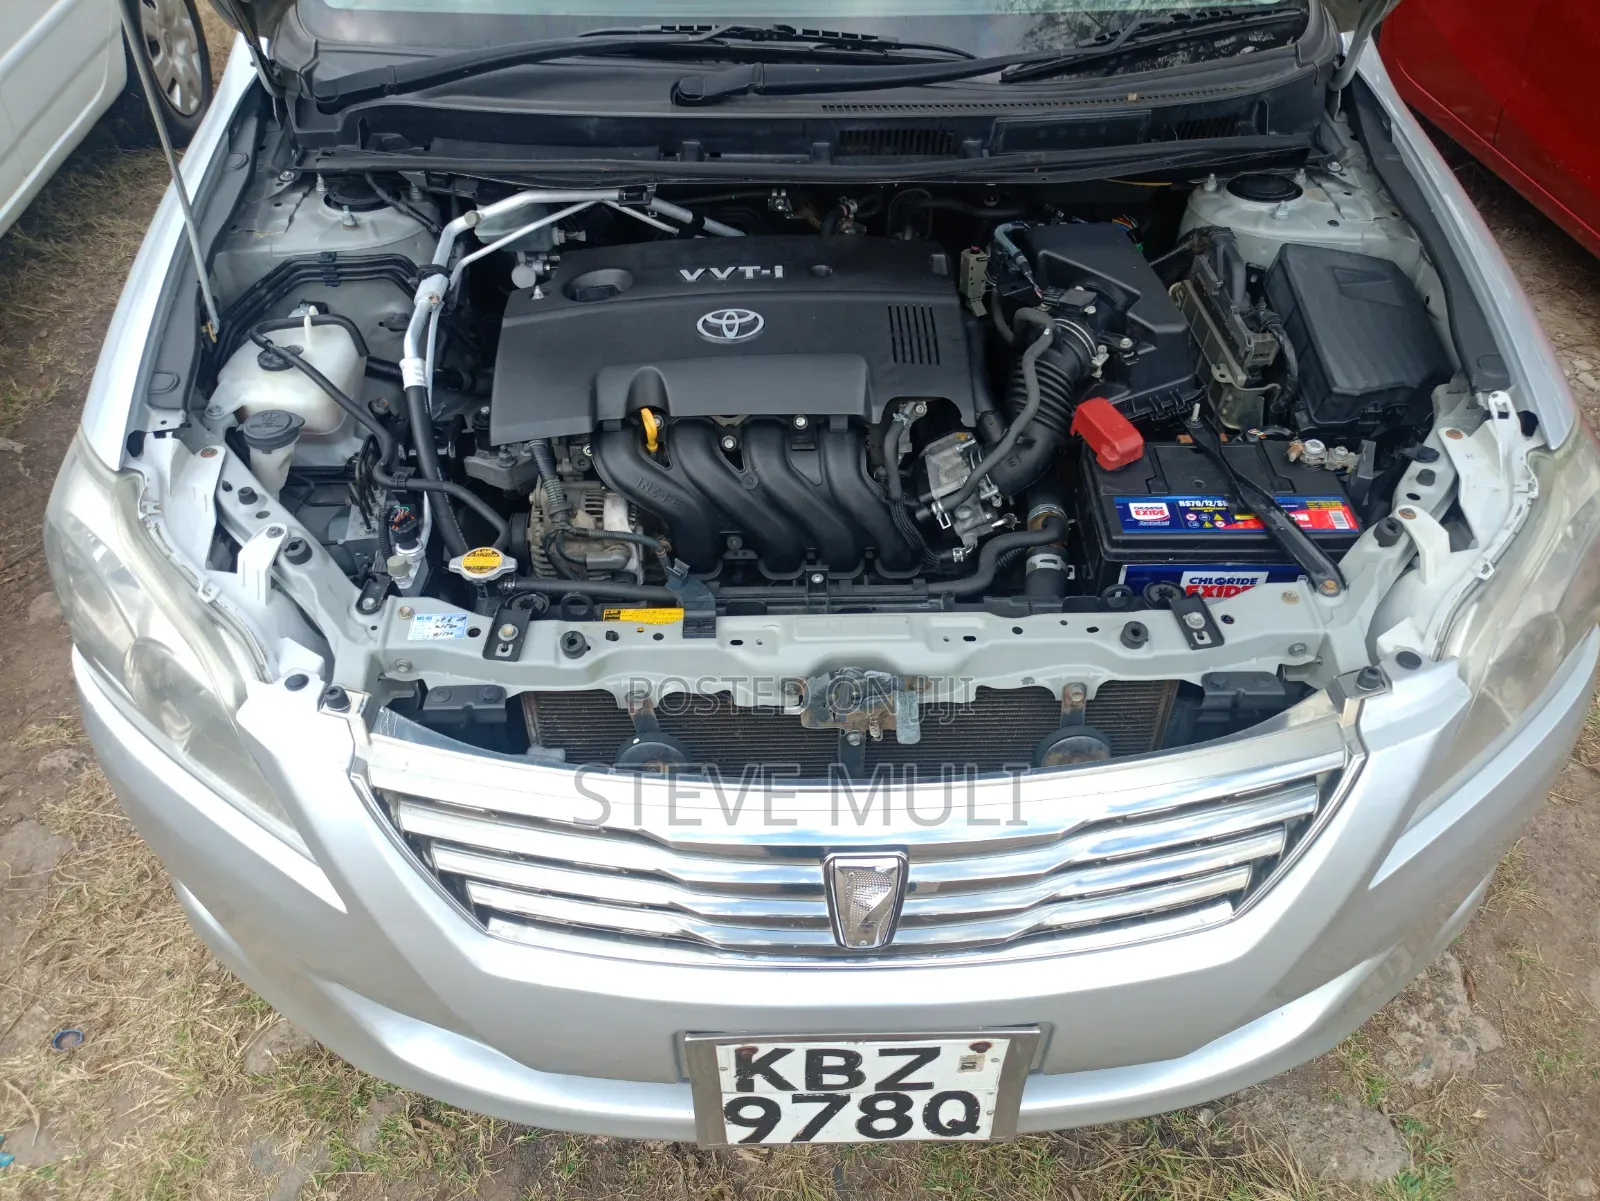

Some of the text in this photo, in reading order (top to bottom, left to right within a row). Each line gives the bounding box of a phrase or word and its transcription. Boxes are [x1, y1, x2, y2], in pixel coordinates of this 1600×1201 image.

[1189, 577, 1259, 585] CHLORIDE
[734, 1045, 942, 1093] KBZ
[723, 1090, 981, 1144] 978Q
